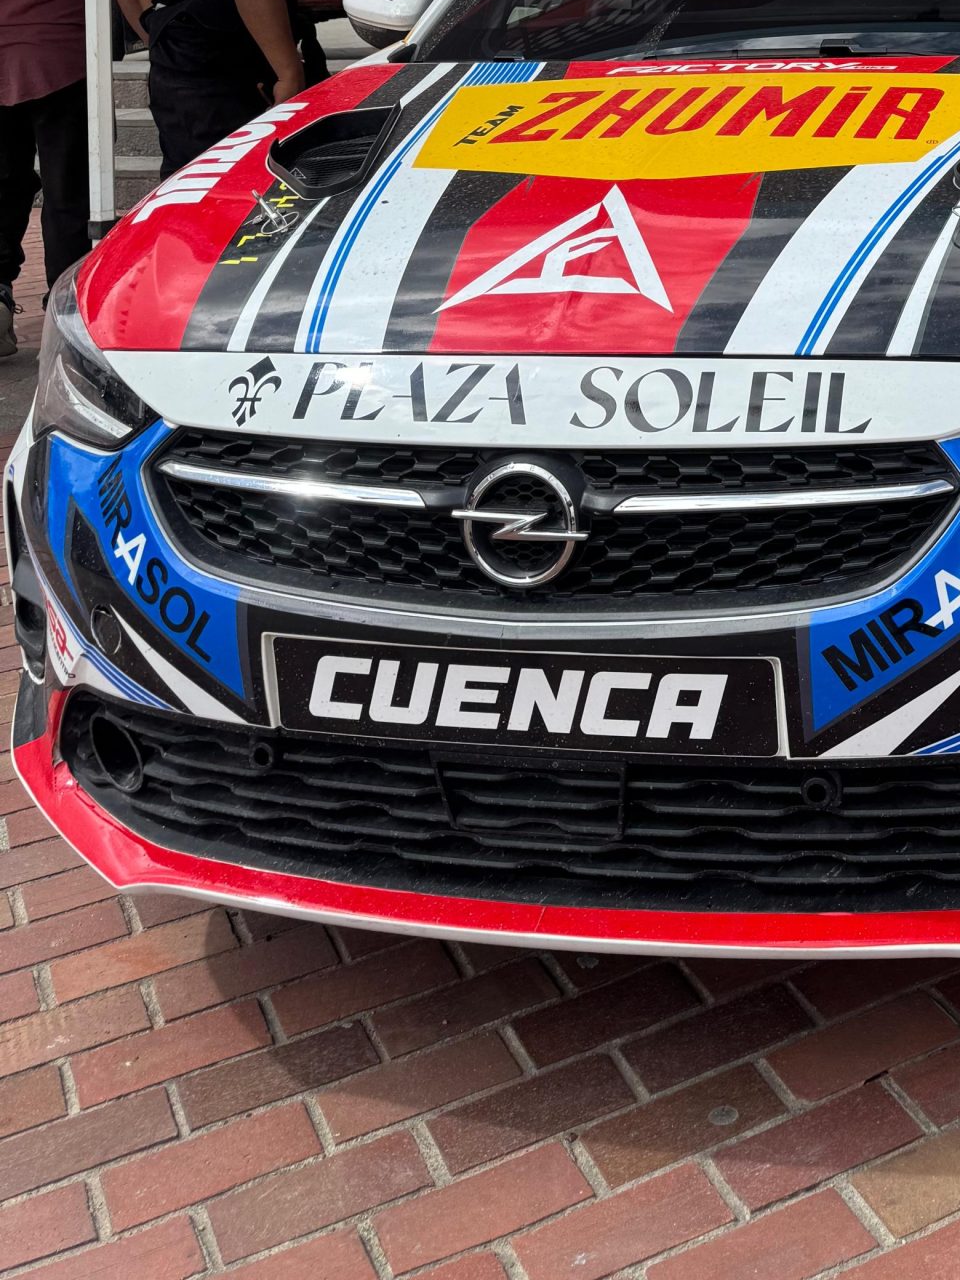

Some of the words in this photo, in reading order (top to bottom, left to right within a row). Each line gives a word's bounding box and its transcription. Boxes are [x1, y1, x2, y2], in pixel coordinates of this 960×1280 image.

[606, 61, 856, 75] FACTORY
[131, 101, 310, 225] MOTUL
[453, 104, 526, 147] TEAM
[292, 361, 527, 426] PLAZA
[570, 366, 872, 436] SOLEIL
[97, 454, 213, 664] MIRASOL
[307, 654, 729, 740] CUENCA
